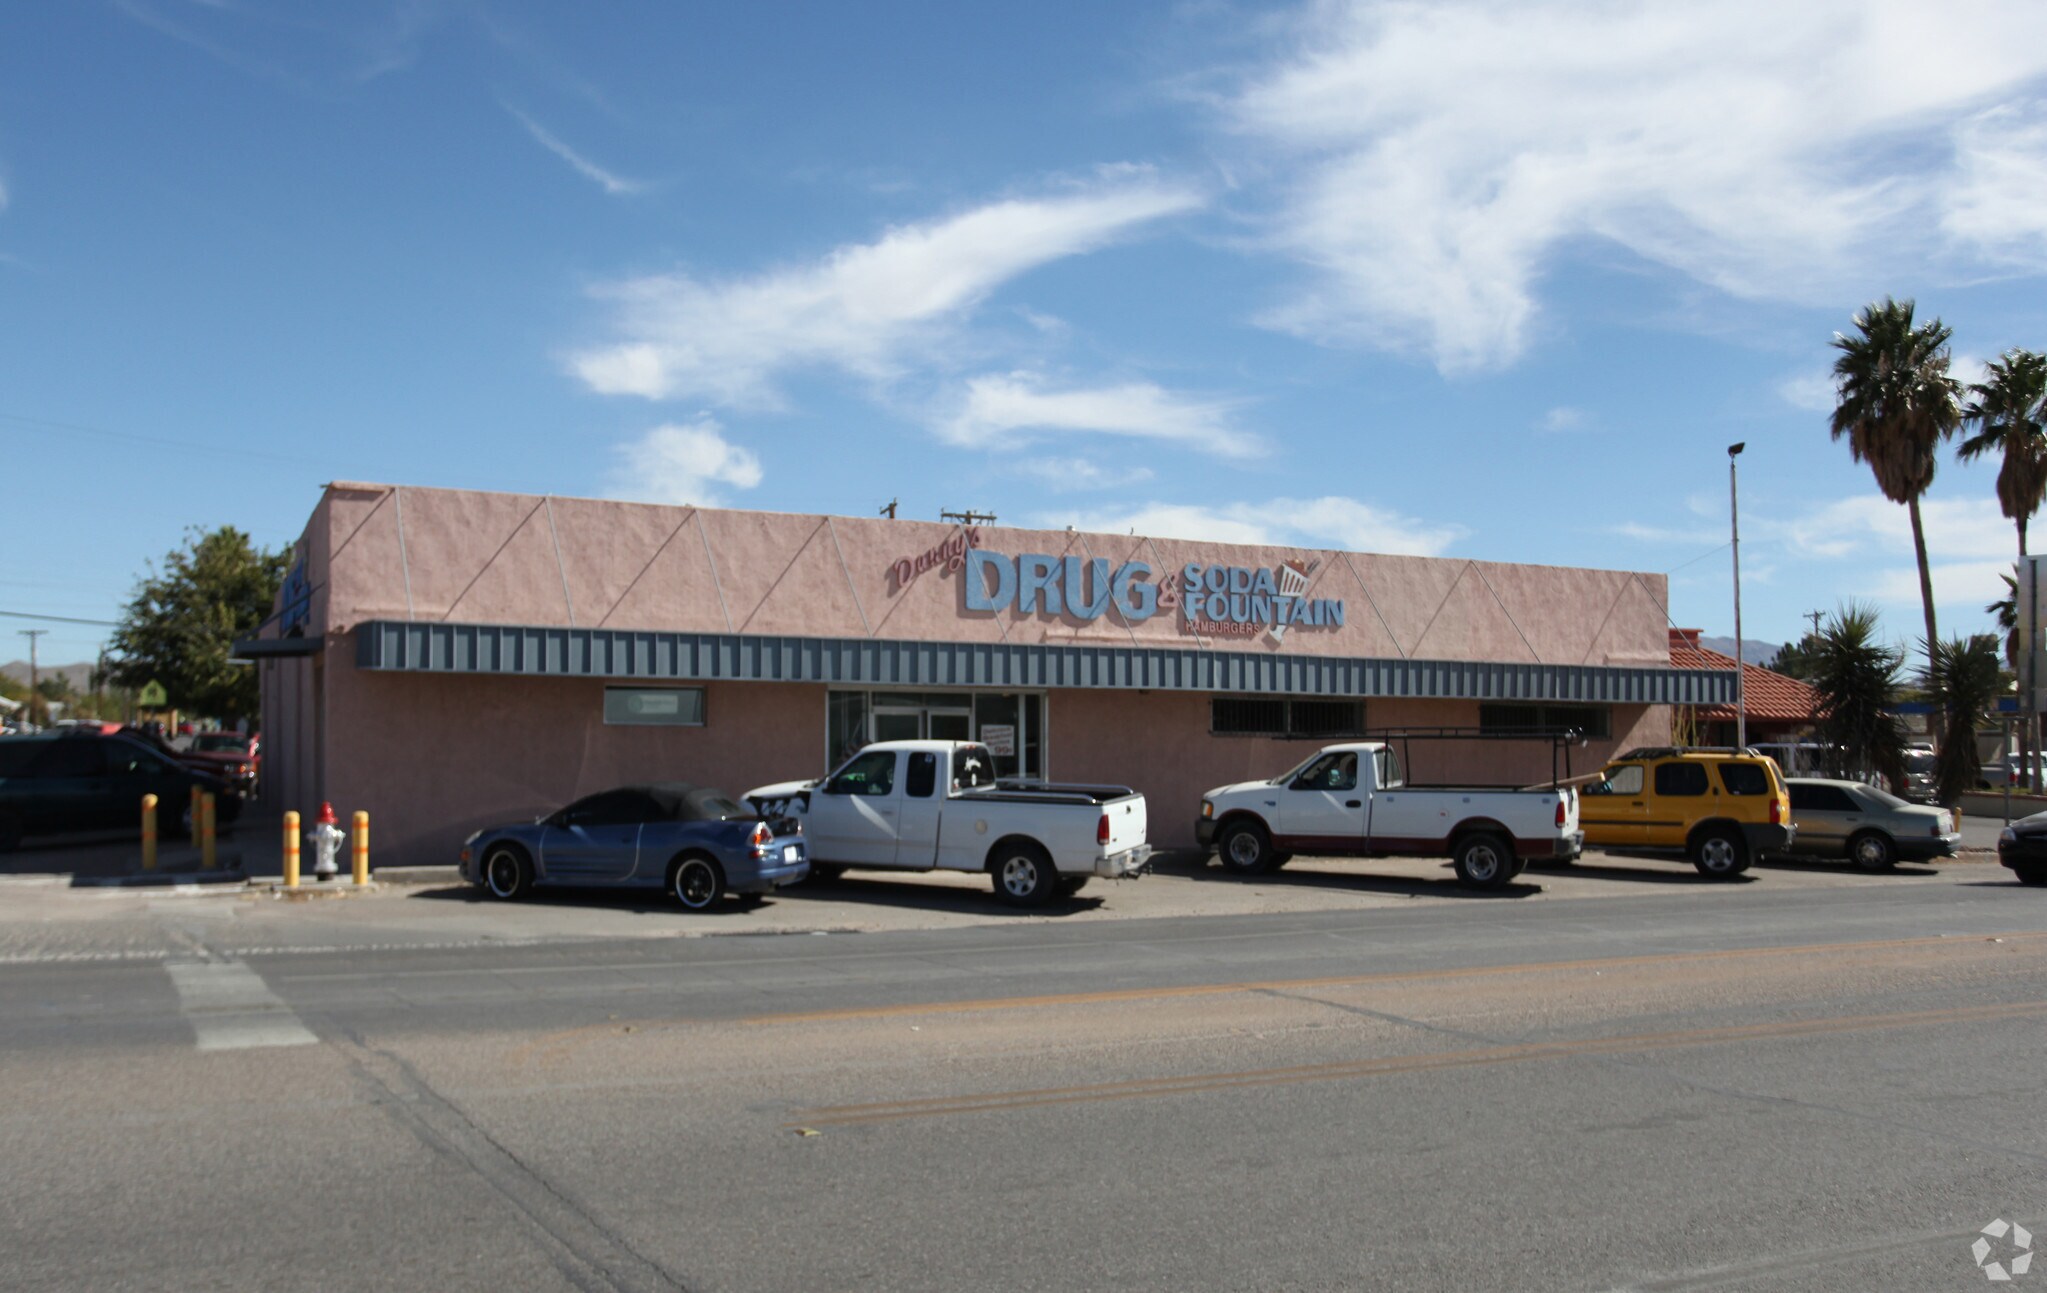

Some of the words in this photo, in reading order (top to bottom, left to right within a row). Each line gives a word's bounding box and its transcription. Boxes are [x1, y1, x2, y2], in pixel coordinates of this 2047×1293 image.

[965, 549, 1157, 620] DRUG
[1157, 568, 1180, 607] &
[1184, 563, 1278, 595] SODA
[1184, 592, 1345, 627] FOUNTAIN
[1185, 621, 1260, 635] HAMBURGERS
